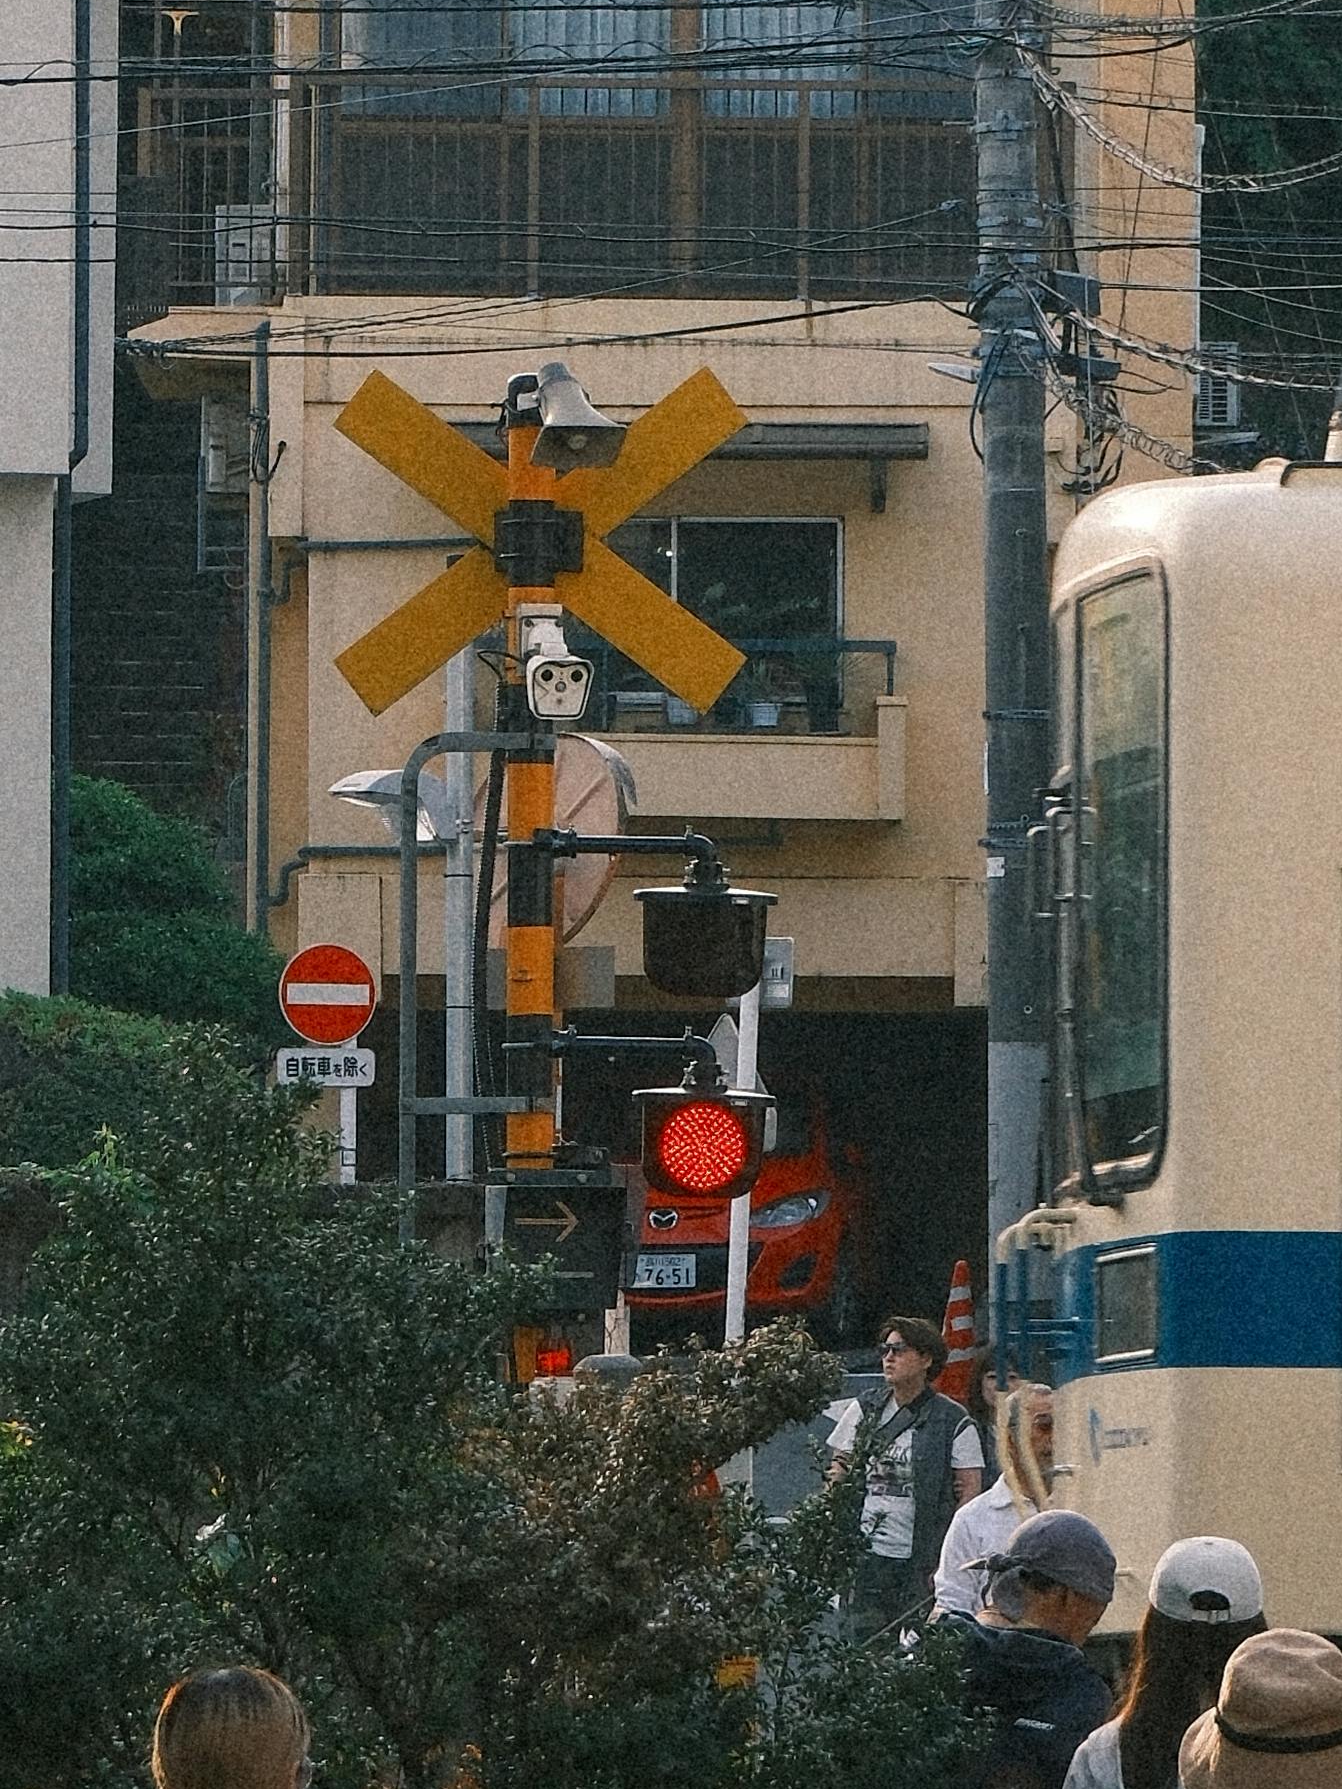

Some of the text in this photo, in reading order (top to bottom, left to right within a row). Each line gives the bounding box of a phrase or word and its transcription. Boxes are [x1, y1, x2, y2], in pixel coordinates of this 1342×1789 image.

[286, 1056, 368, 1077] 自転車を除く
